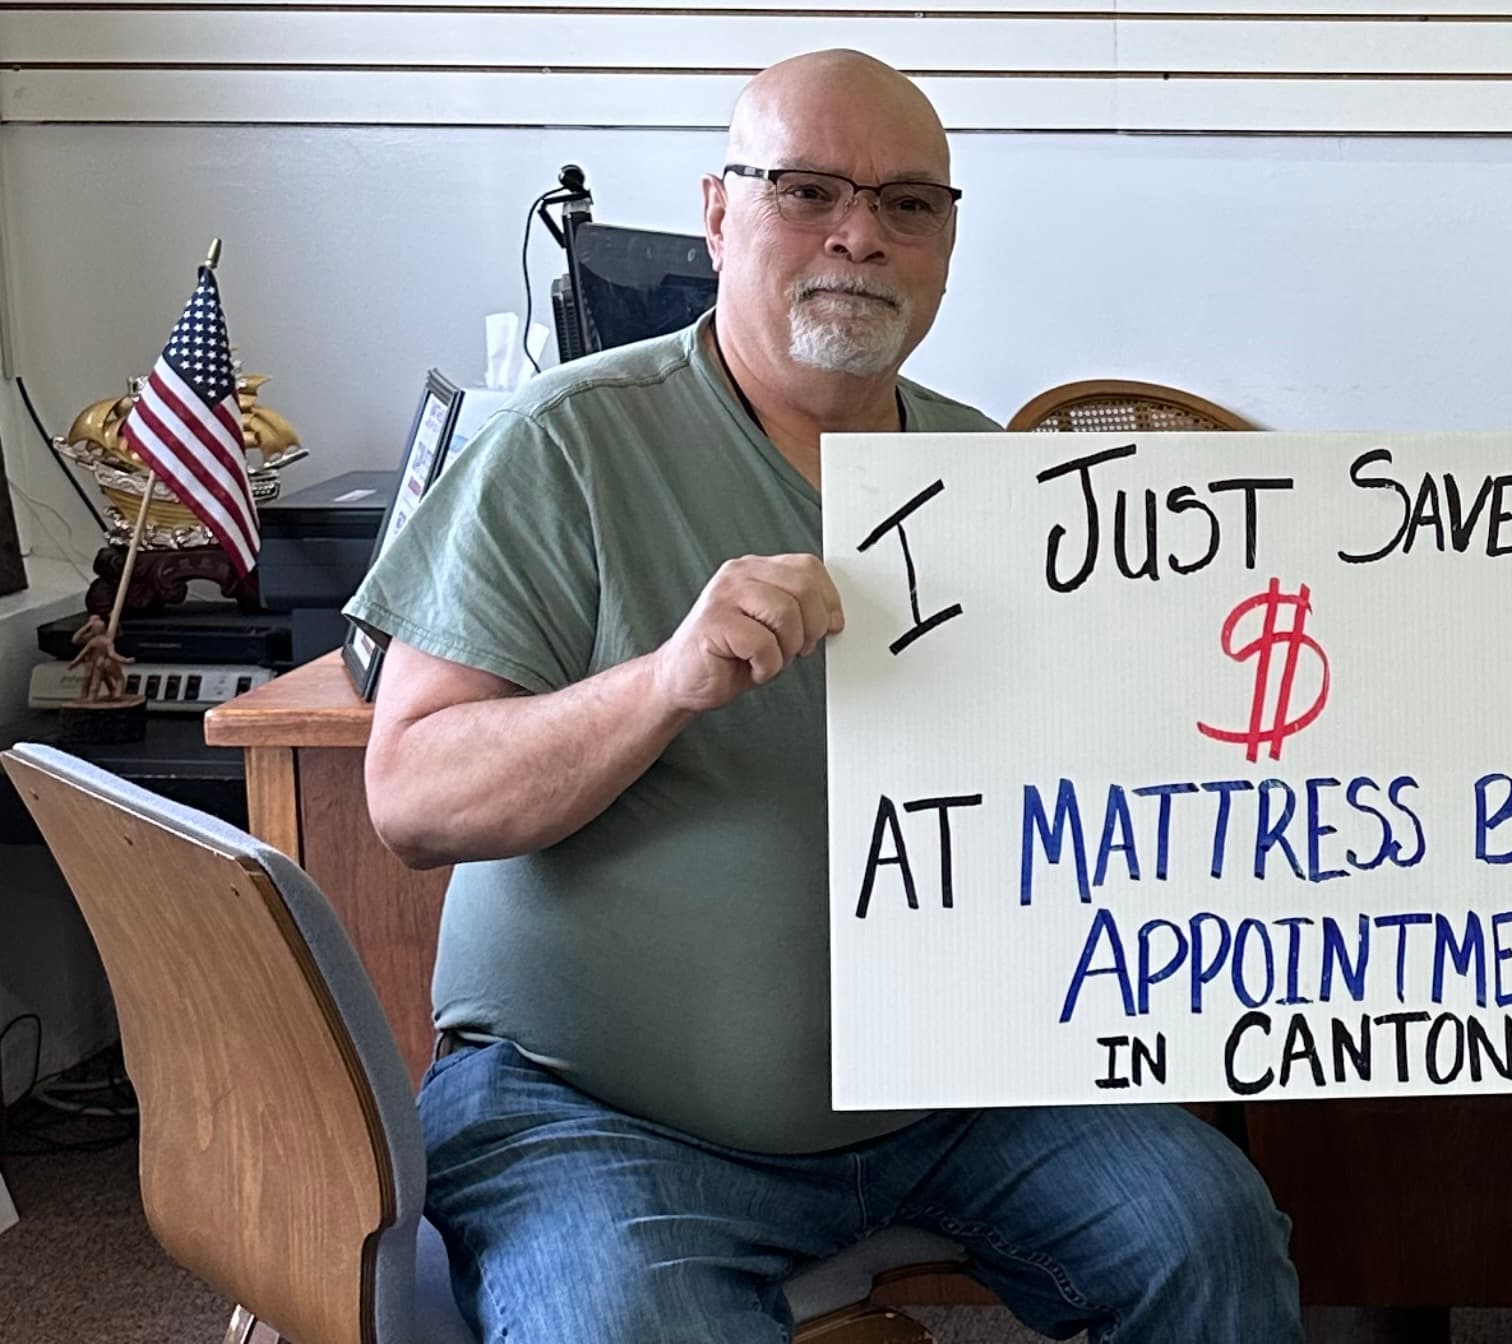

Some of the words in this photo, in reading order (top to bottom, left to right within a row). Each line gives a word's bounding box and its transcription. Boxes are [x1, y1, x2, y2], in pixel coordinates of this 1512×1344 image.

[857, 480, 962, 655] I
[1037, 444, 1294, 593] JUST
[1197, 577, 1330, 763] $
[856, 794, 982, 918] AT
[1021, 777, 1425, 906] MATTRESS
[1095, 1032, 1166, 1089] IN
